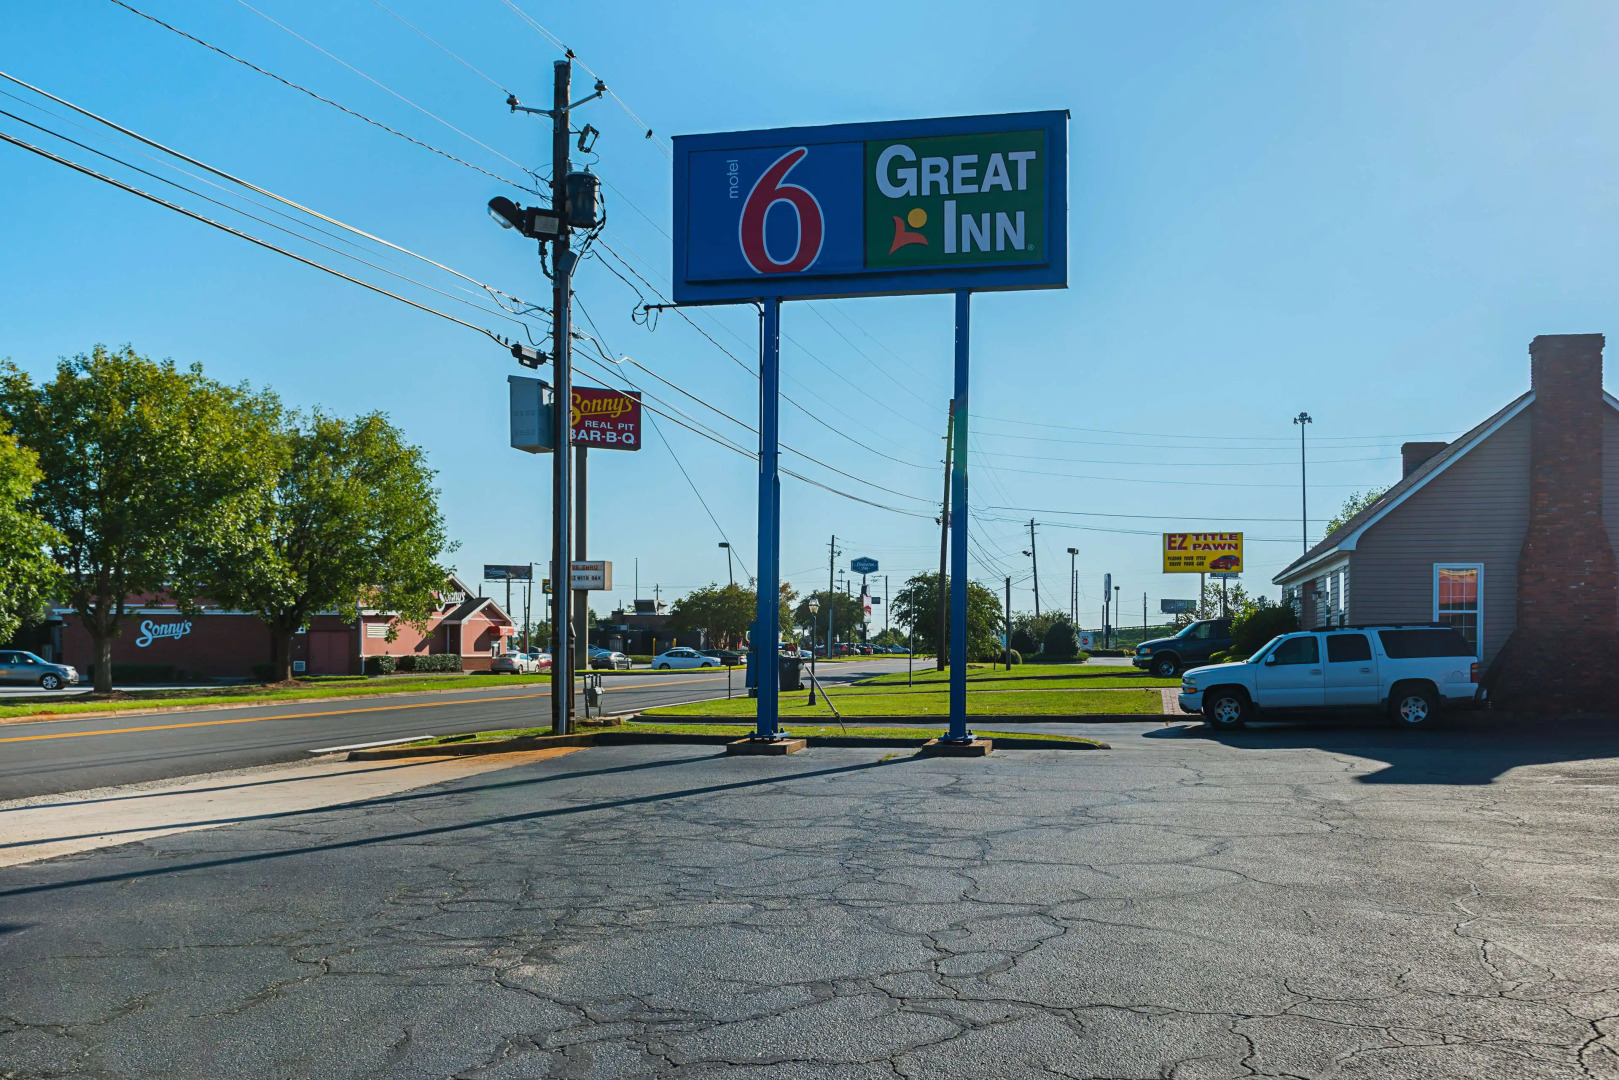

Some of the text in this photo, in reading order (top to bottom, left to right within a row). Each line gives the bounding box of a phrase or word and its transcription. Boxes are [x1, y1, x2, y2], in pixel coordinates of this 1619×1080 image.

[875, 143, 1037, 199] GREAT
[726, 146, 825, 274] motel 6
[943, 199, 1025, 254] INN
[585, 420, 635, 431] REAL PIT
[1166, 533, 1239, 551] EZ TITLE
[1191, 543, 1239, 551] PAWN
[136, 619, 192, 648] Sonny's
